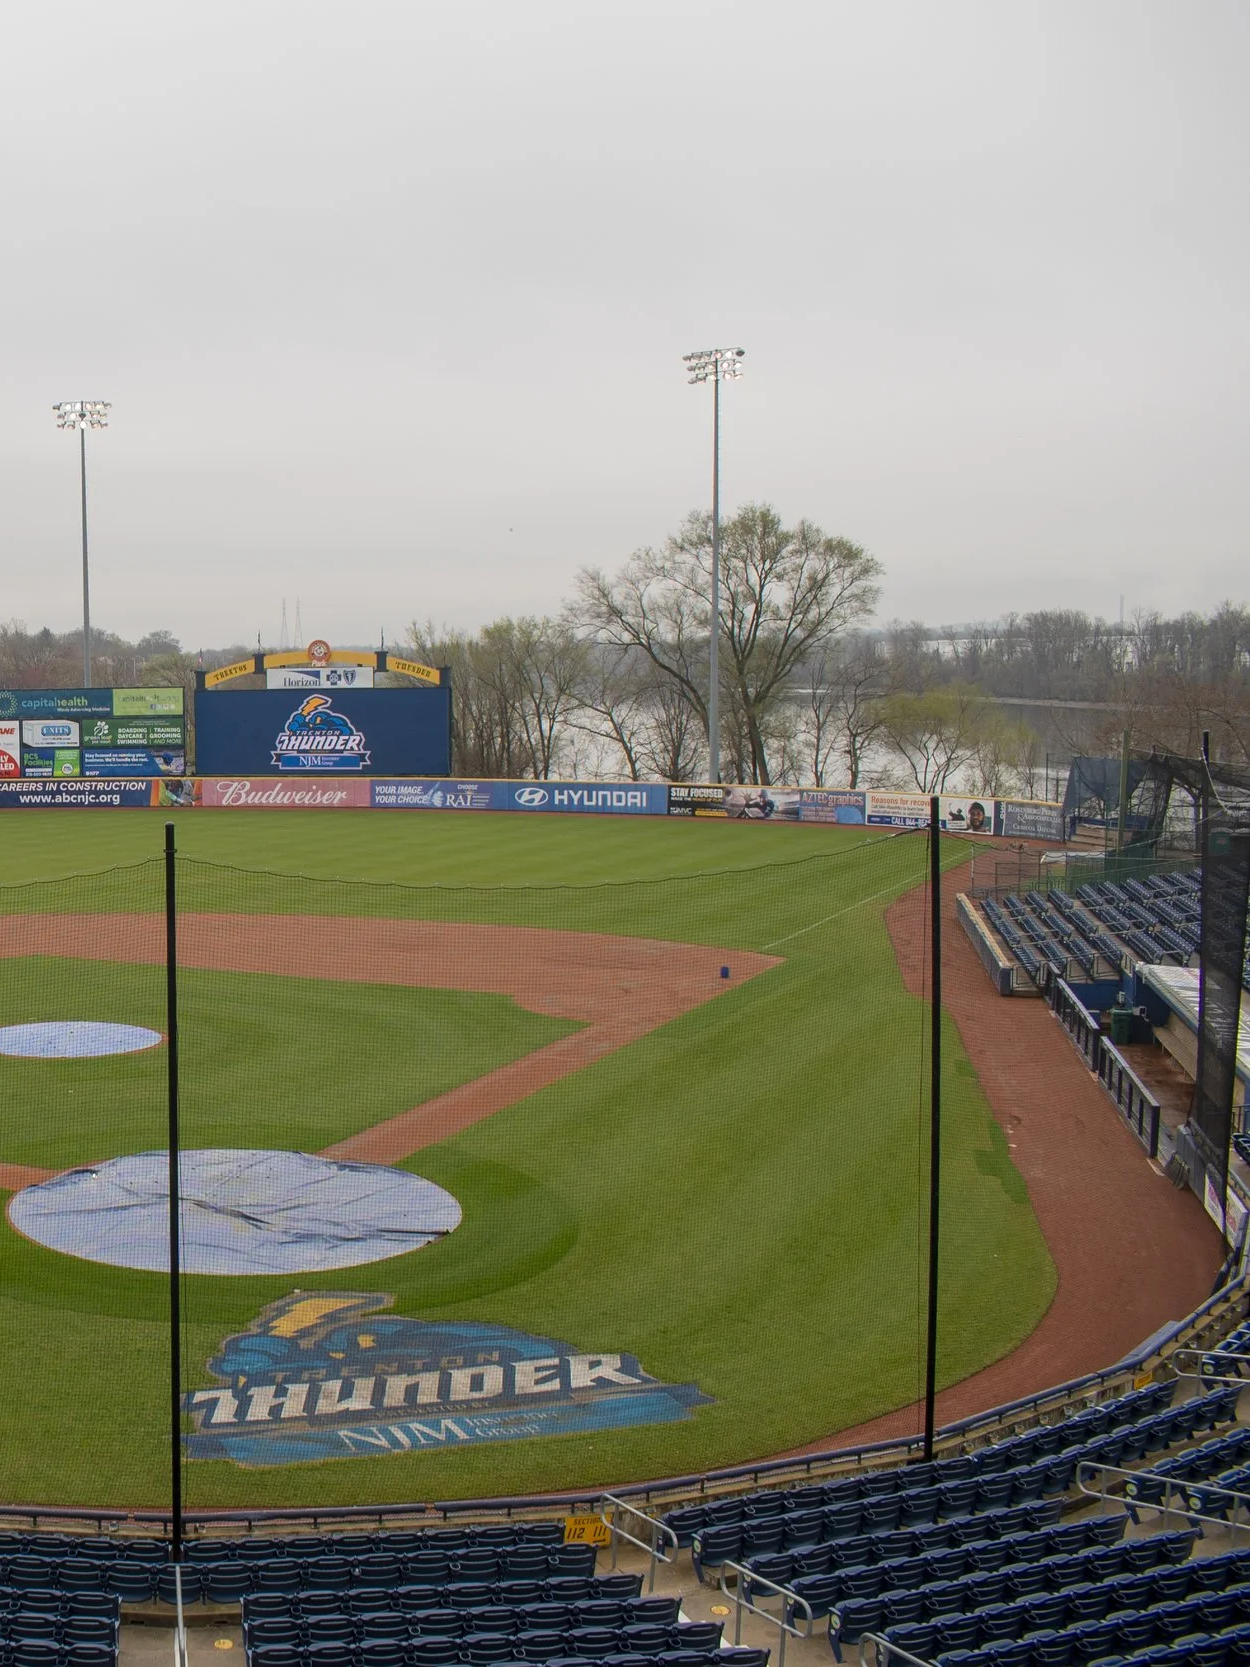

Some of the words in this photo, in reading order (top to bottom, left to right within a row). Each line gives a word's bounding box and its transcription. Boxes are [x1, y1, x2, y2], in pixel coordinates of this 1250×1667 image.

[283, 677, 321, 687] Horizon
[280, 736, 362, 751] THUNDER
[299, 756, 322, 768] NJM
[45, 782, 59, 791] IN
[60, 782, 146, 791] CONSTRUCTION
[216, 780, 348, 806] Budweiser
[375, 786, 396, 794] YOUR
[398, 786, 424, 794] IMAGE.
[671, 787, 690, 797] STAY
[690, 788, 723, 798] FOCUSED
[20, 792, 120, 805] www.abcnjc.org
[375, 795, 397, 804] YOUR
[554, 789, 646, 808] HYUNDAI
[802, 792, 828, 803] AZTEC
[829, 792, 864, 806] graphics
[871, 796, 898, 804] Reasons
[892, 817, 904, 825] CALL
[192, 1353, 642, 1425] THUNDER
[337, 1418, 471, 1452] NJM
[474, 1424, 541, 1439] Group
[567, 1528, 585, 1539] 112
[593, 1525, 606, 1537] 111
